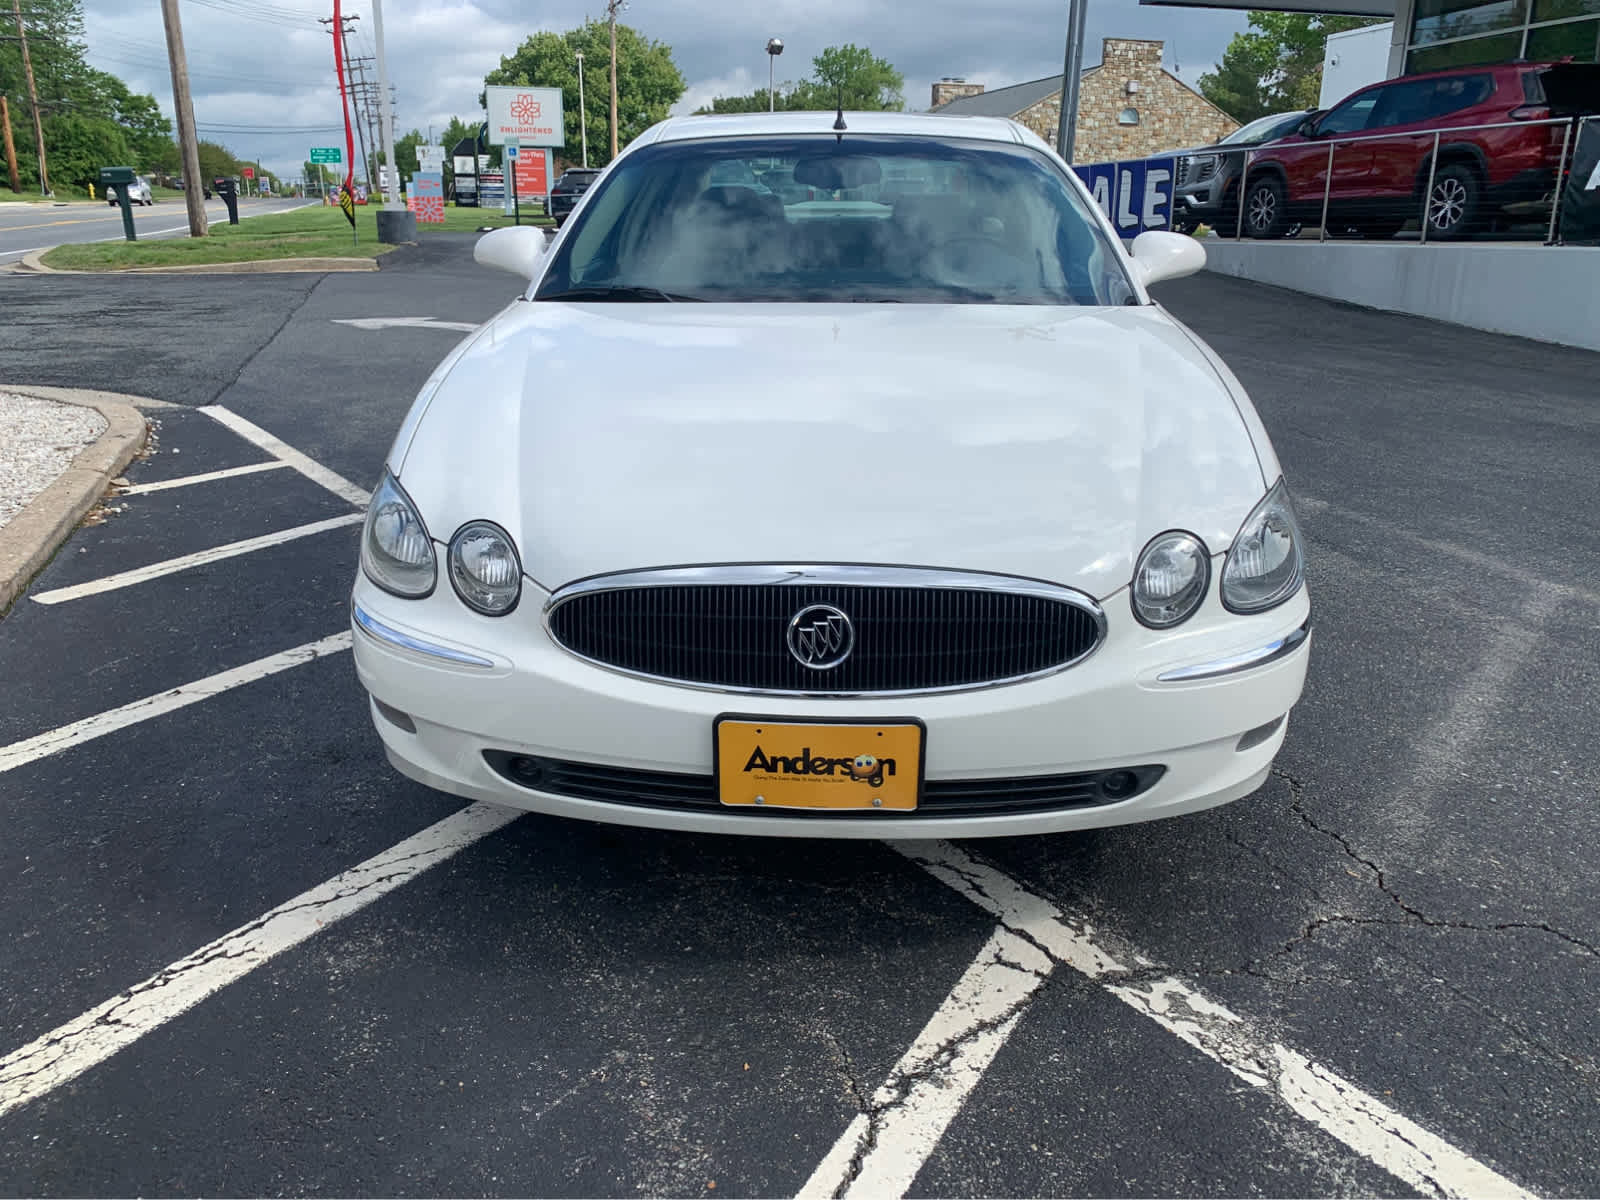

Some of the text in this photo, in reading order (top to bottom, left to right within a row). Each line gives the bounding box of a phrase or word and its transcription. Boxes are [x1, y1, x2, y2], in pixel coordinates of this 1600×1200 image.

[500, 126, 553, 135] ENLIGHTENED
[1091, 169, 1170, 228] ALE
[743, 745, 897, 777] Anderson
